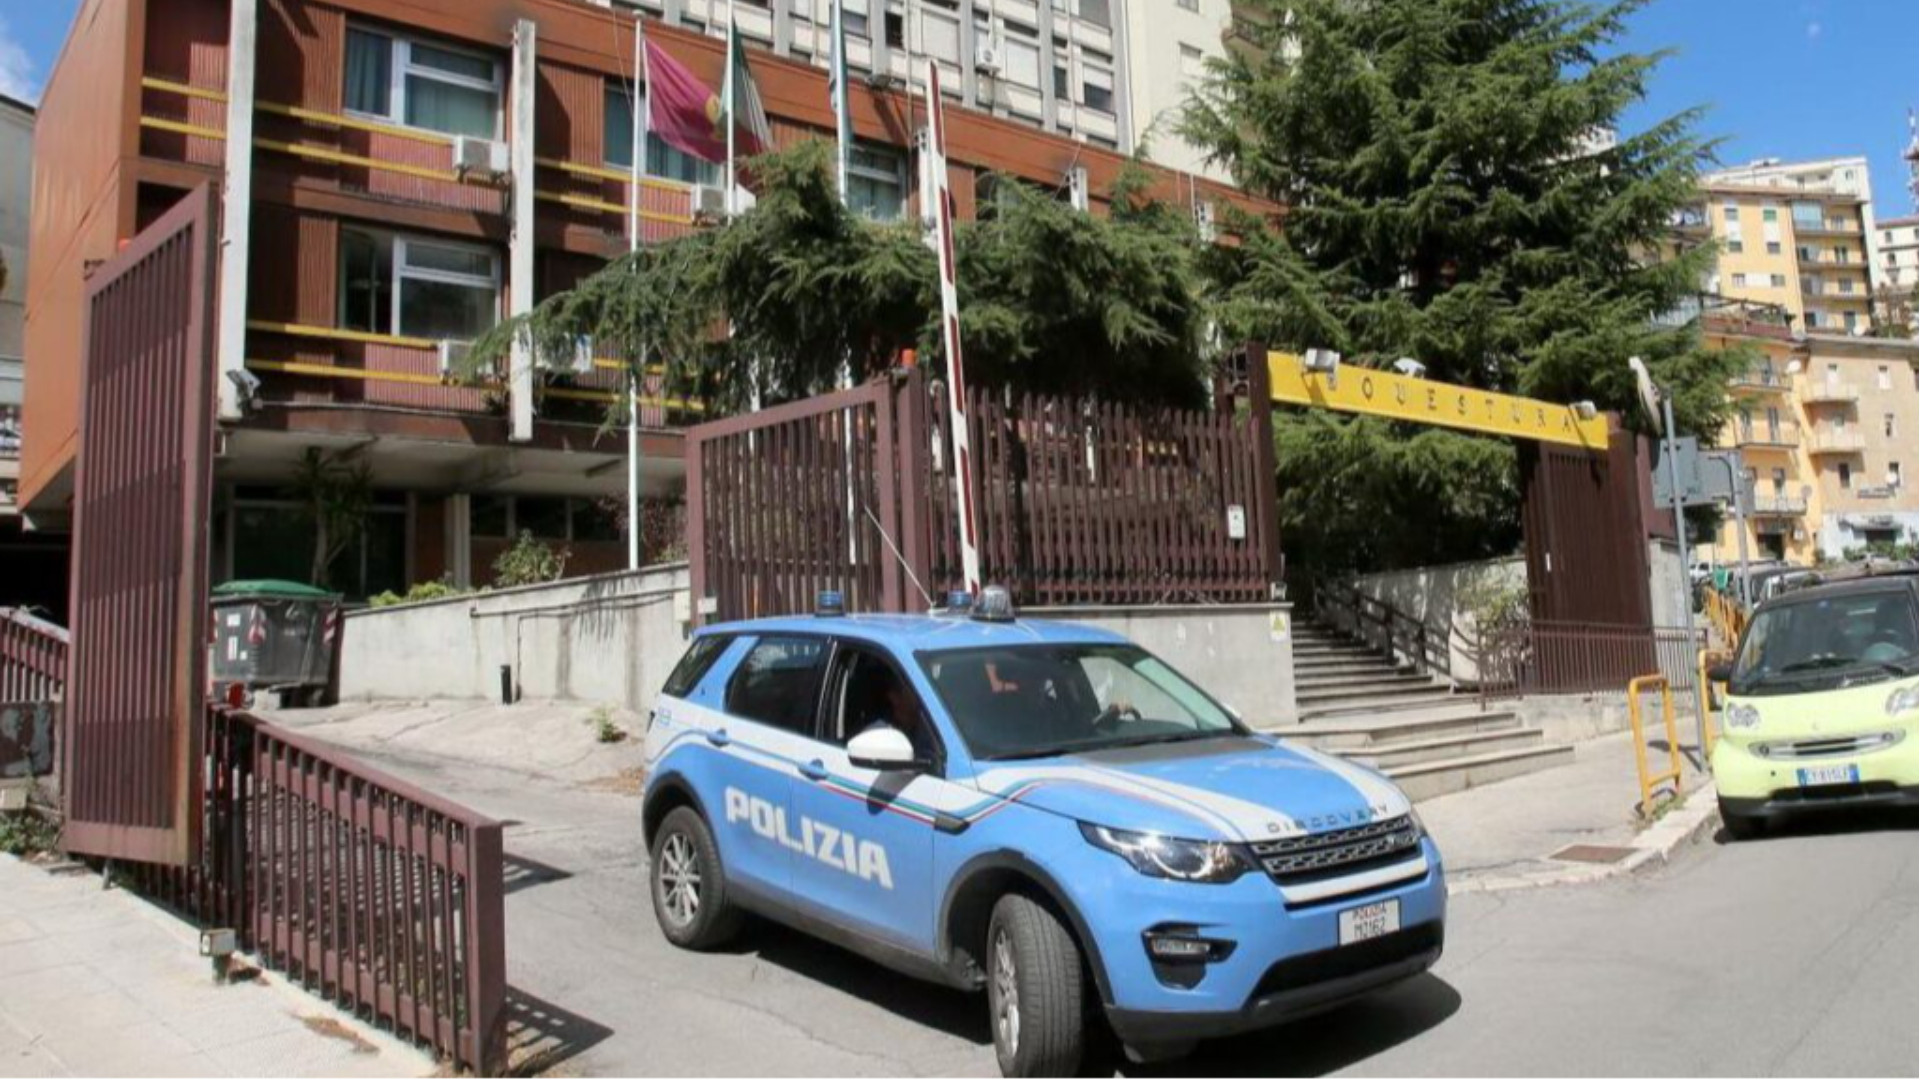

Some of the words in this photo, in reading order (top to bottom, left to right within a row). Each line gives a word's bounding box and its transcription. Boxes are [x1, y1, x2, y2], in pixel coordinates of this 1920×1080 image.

[1362, 377, 1571, 432] QUESTURA
[725, 787, 893, 890] POLIZIA
[1267, 804, 1388, 833] DISCOVERY
